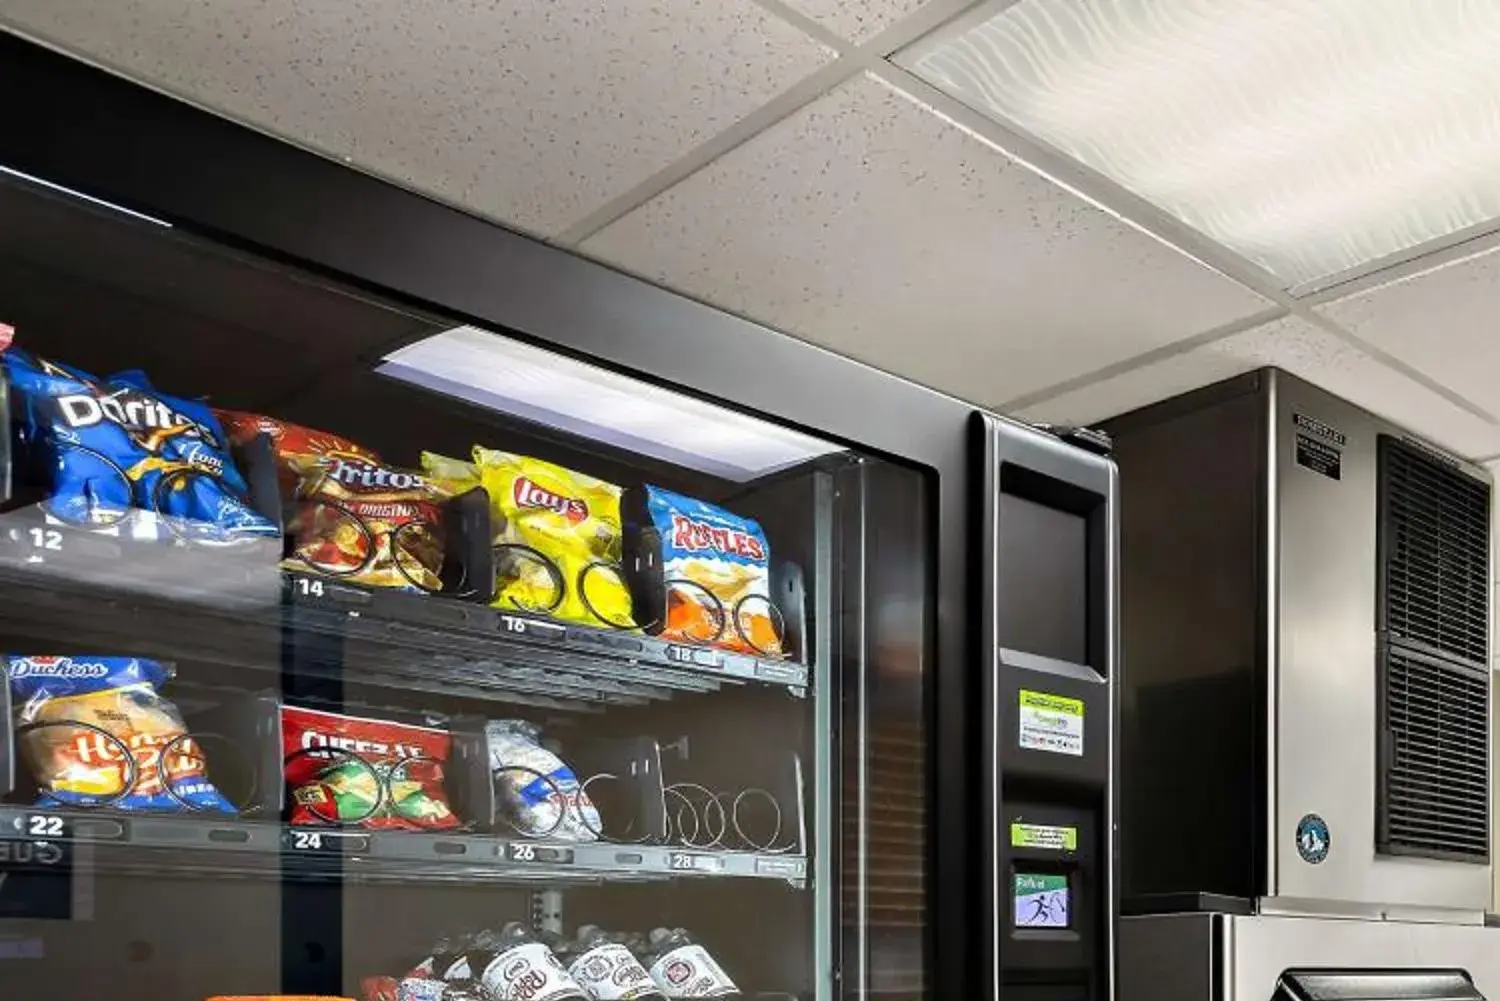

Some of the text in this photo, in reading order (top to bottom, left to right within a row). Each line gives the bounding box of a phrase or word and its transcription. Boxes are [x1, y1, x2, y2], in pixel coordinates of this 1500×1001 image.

[29, 527, 63, 551] 12
[299, 579, 324, 597] 14
[505, 616, 525, 633] 16
[10, 656, 109, 679] Duchess
[29, 815, 65, 837] 22
[295, 833, 322, 850] 24
[513, 845, 535, 861] 26
[673, 854, 692, 869] 28
